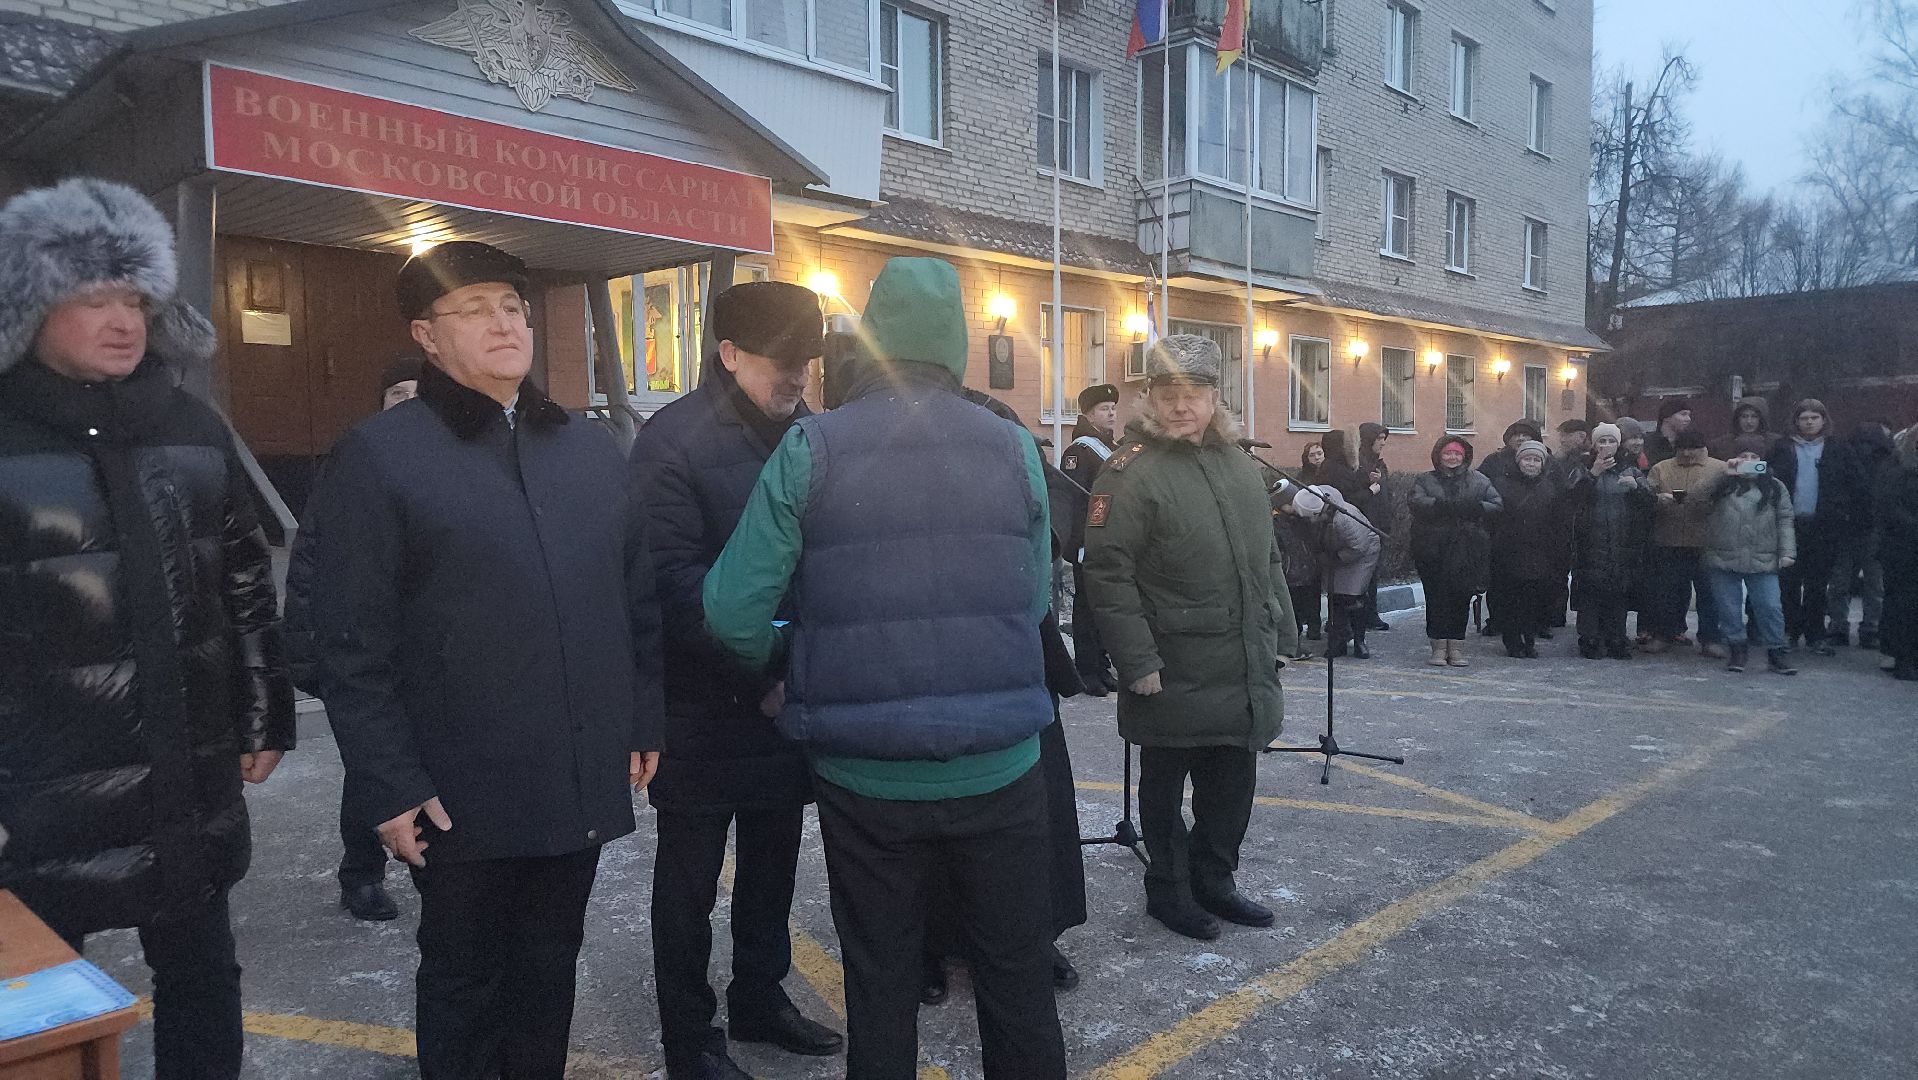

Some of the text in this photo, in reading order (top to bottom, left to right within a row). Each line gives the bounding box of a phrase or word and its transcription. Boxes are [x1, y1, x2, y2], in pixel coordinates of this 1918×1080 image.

[233, 86, 480, 159] ВОЕННЫЙ
[262, 131, 747, 236] МОСКОВСКОЙ ОБЛАСТИ
